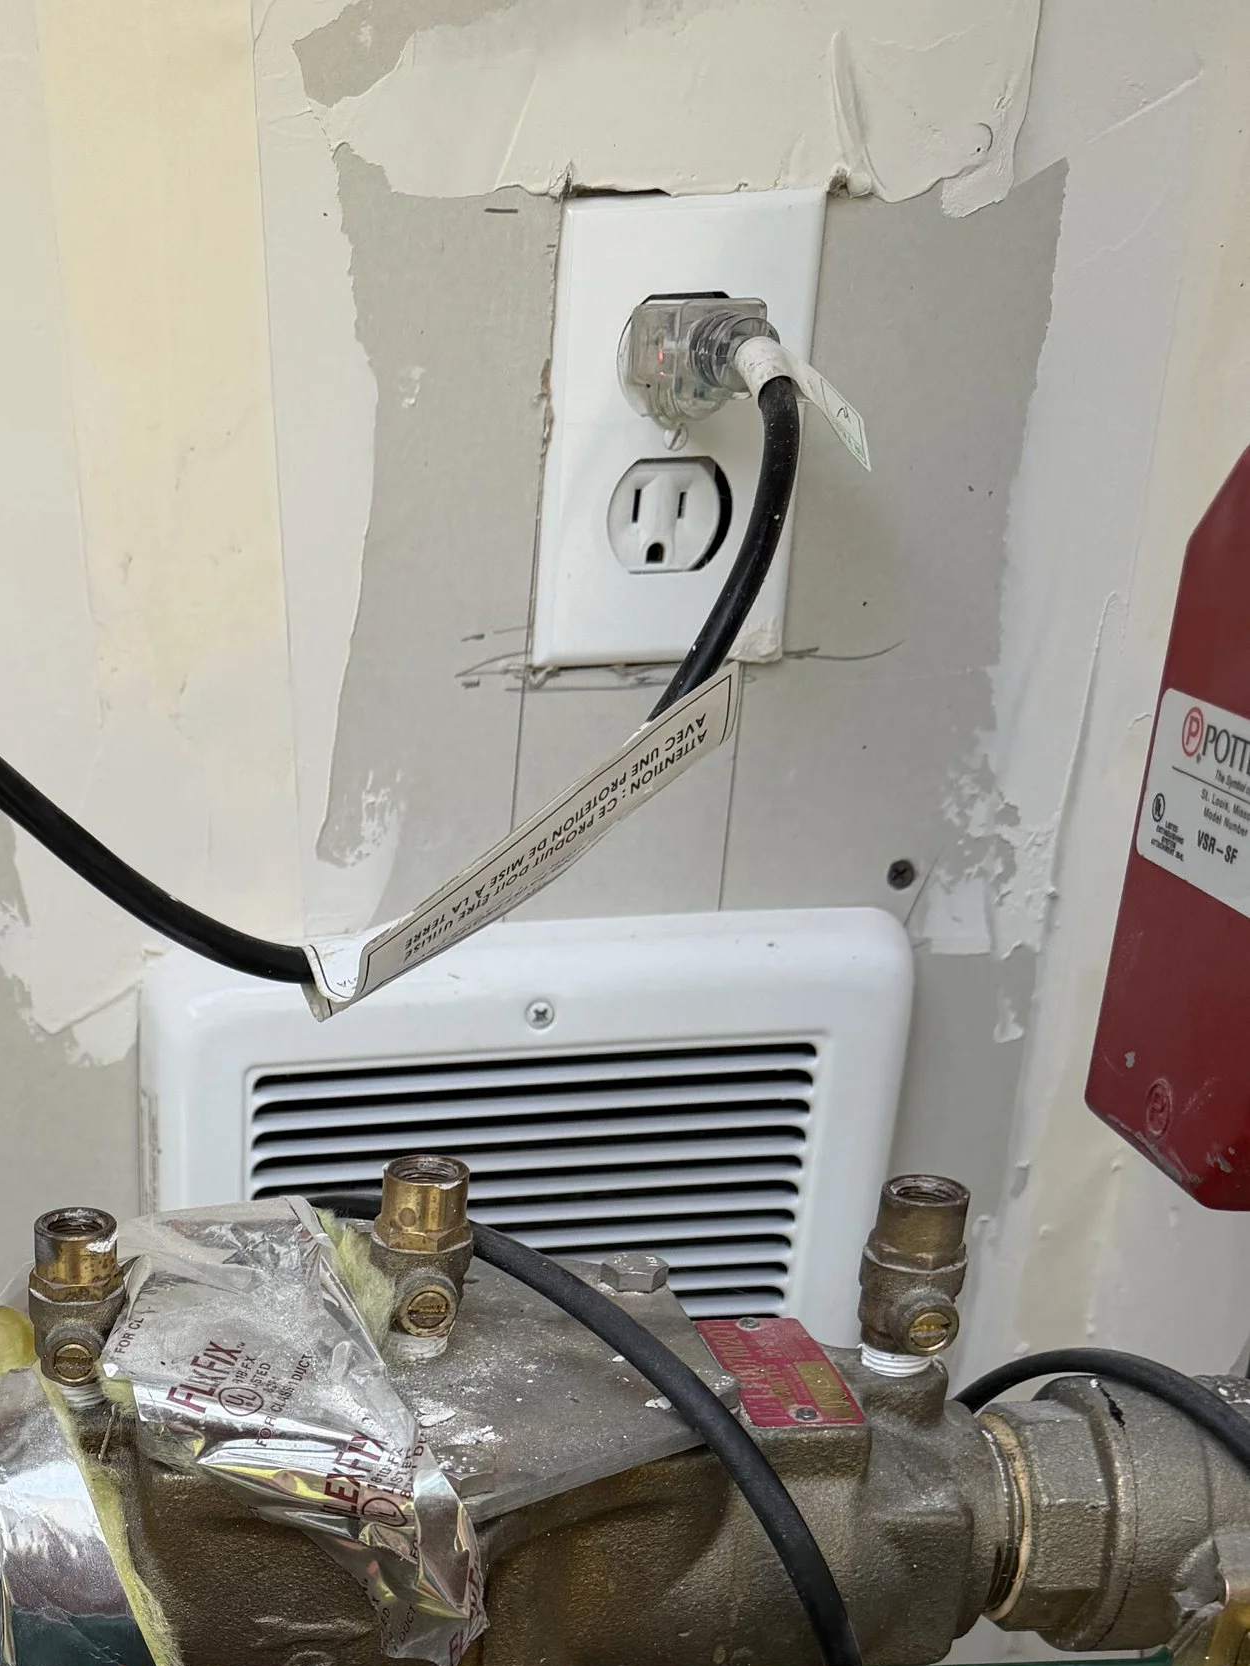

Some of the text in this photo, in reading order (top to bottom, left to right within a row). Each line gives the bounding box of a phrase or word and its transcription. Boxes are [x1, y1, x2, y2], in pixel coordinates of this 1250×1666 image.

[665, 713, 706, 752] AVEC
[630, 729, 708, 795] ATTENTION
[631, 747, 659, 778] UNE
[552, 771, 627, 842] PROTETION
[598, 797, 618, 815] CE
[528, 837, 548, 858] DE
[532, 819, 594, 869] PRODUIT
[490, 856, 525, 889] MISE
[494, 868, 530, 897] DOIT
[452, 897, 469, 914] LA
[405, 913, 446, 950] TERRE
[115, 1327, 136, 1355] FOR
[255, 1415, 277, 1447] FOR
[292, 1354, 313, 1382] DUCT
